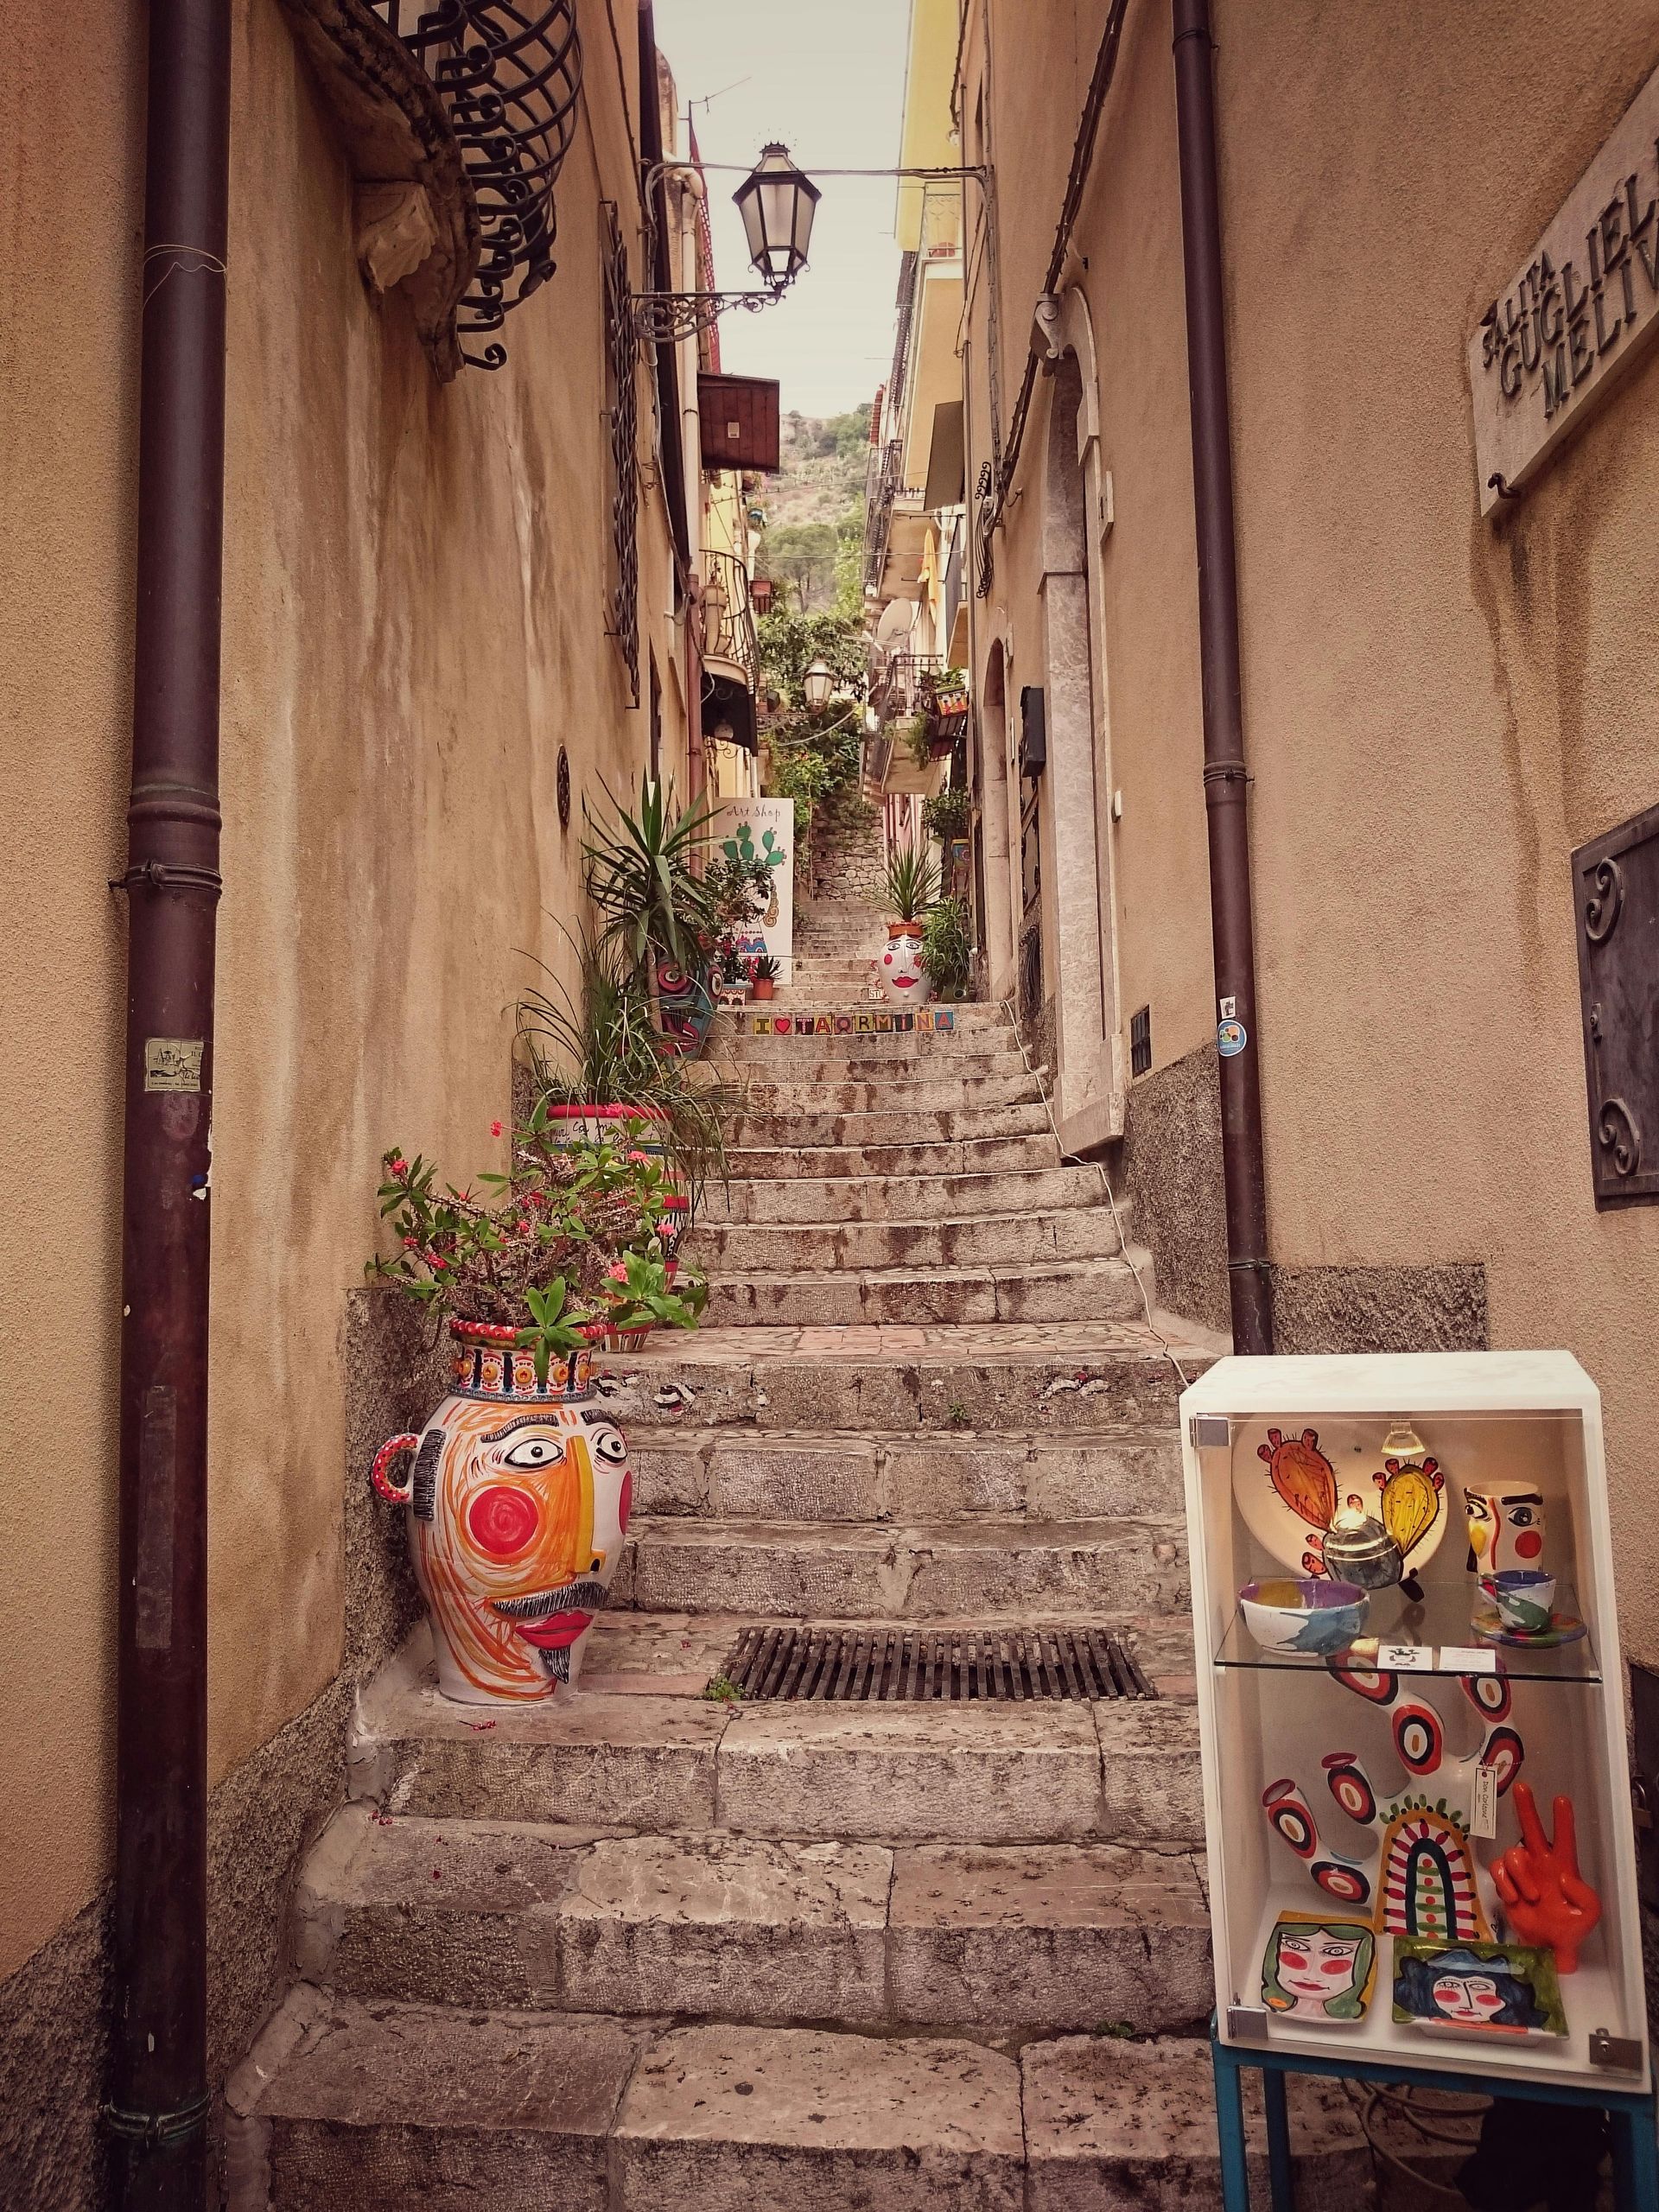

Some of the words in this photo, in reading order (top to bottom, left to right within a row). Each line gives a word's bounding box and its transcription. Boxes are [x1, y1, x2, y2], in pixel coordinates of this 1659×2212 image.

[1501, 137, 1659, 397] GUGLIEL
[1483, 249, 1555, 367] SALITA
[727, 806, 749, 817] Art
[753, 804, 780, 822] Shop
[756, 1019, 771, 1034] I
